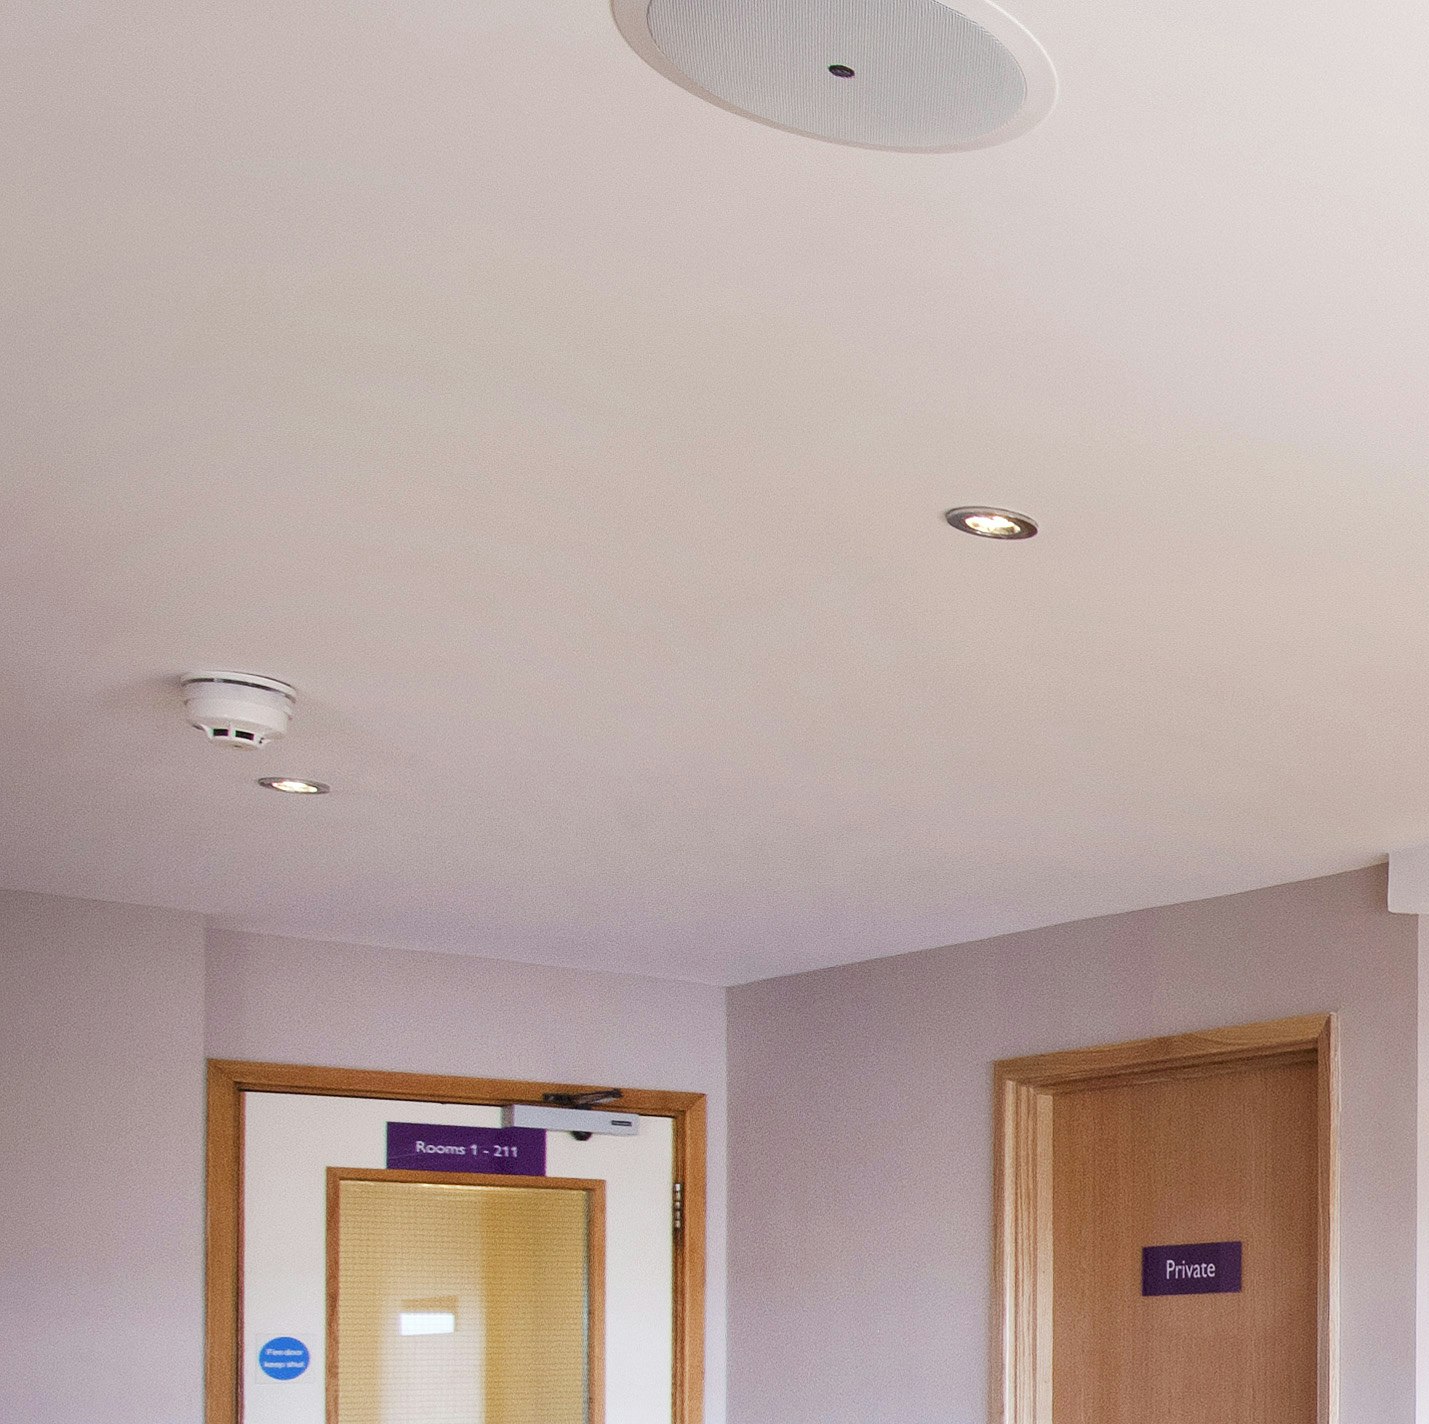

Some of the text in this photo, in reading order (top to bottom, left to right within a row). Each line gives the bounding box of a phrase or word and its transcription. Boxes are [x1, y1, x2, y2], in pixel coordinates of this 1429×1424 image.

[416, 1141, 466, 1155] Rooms
[469, 1144, 478, 1156] 1
[493, 1145, 518, 1158] 211
[1166, 1259, 1216, 1279] Private
